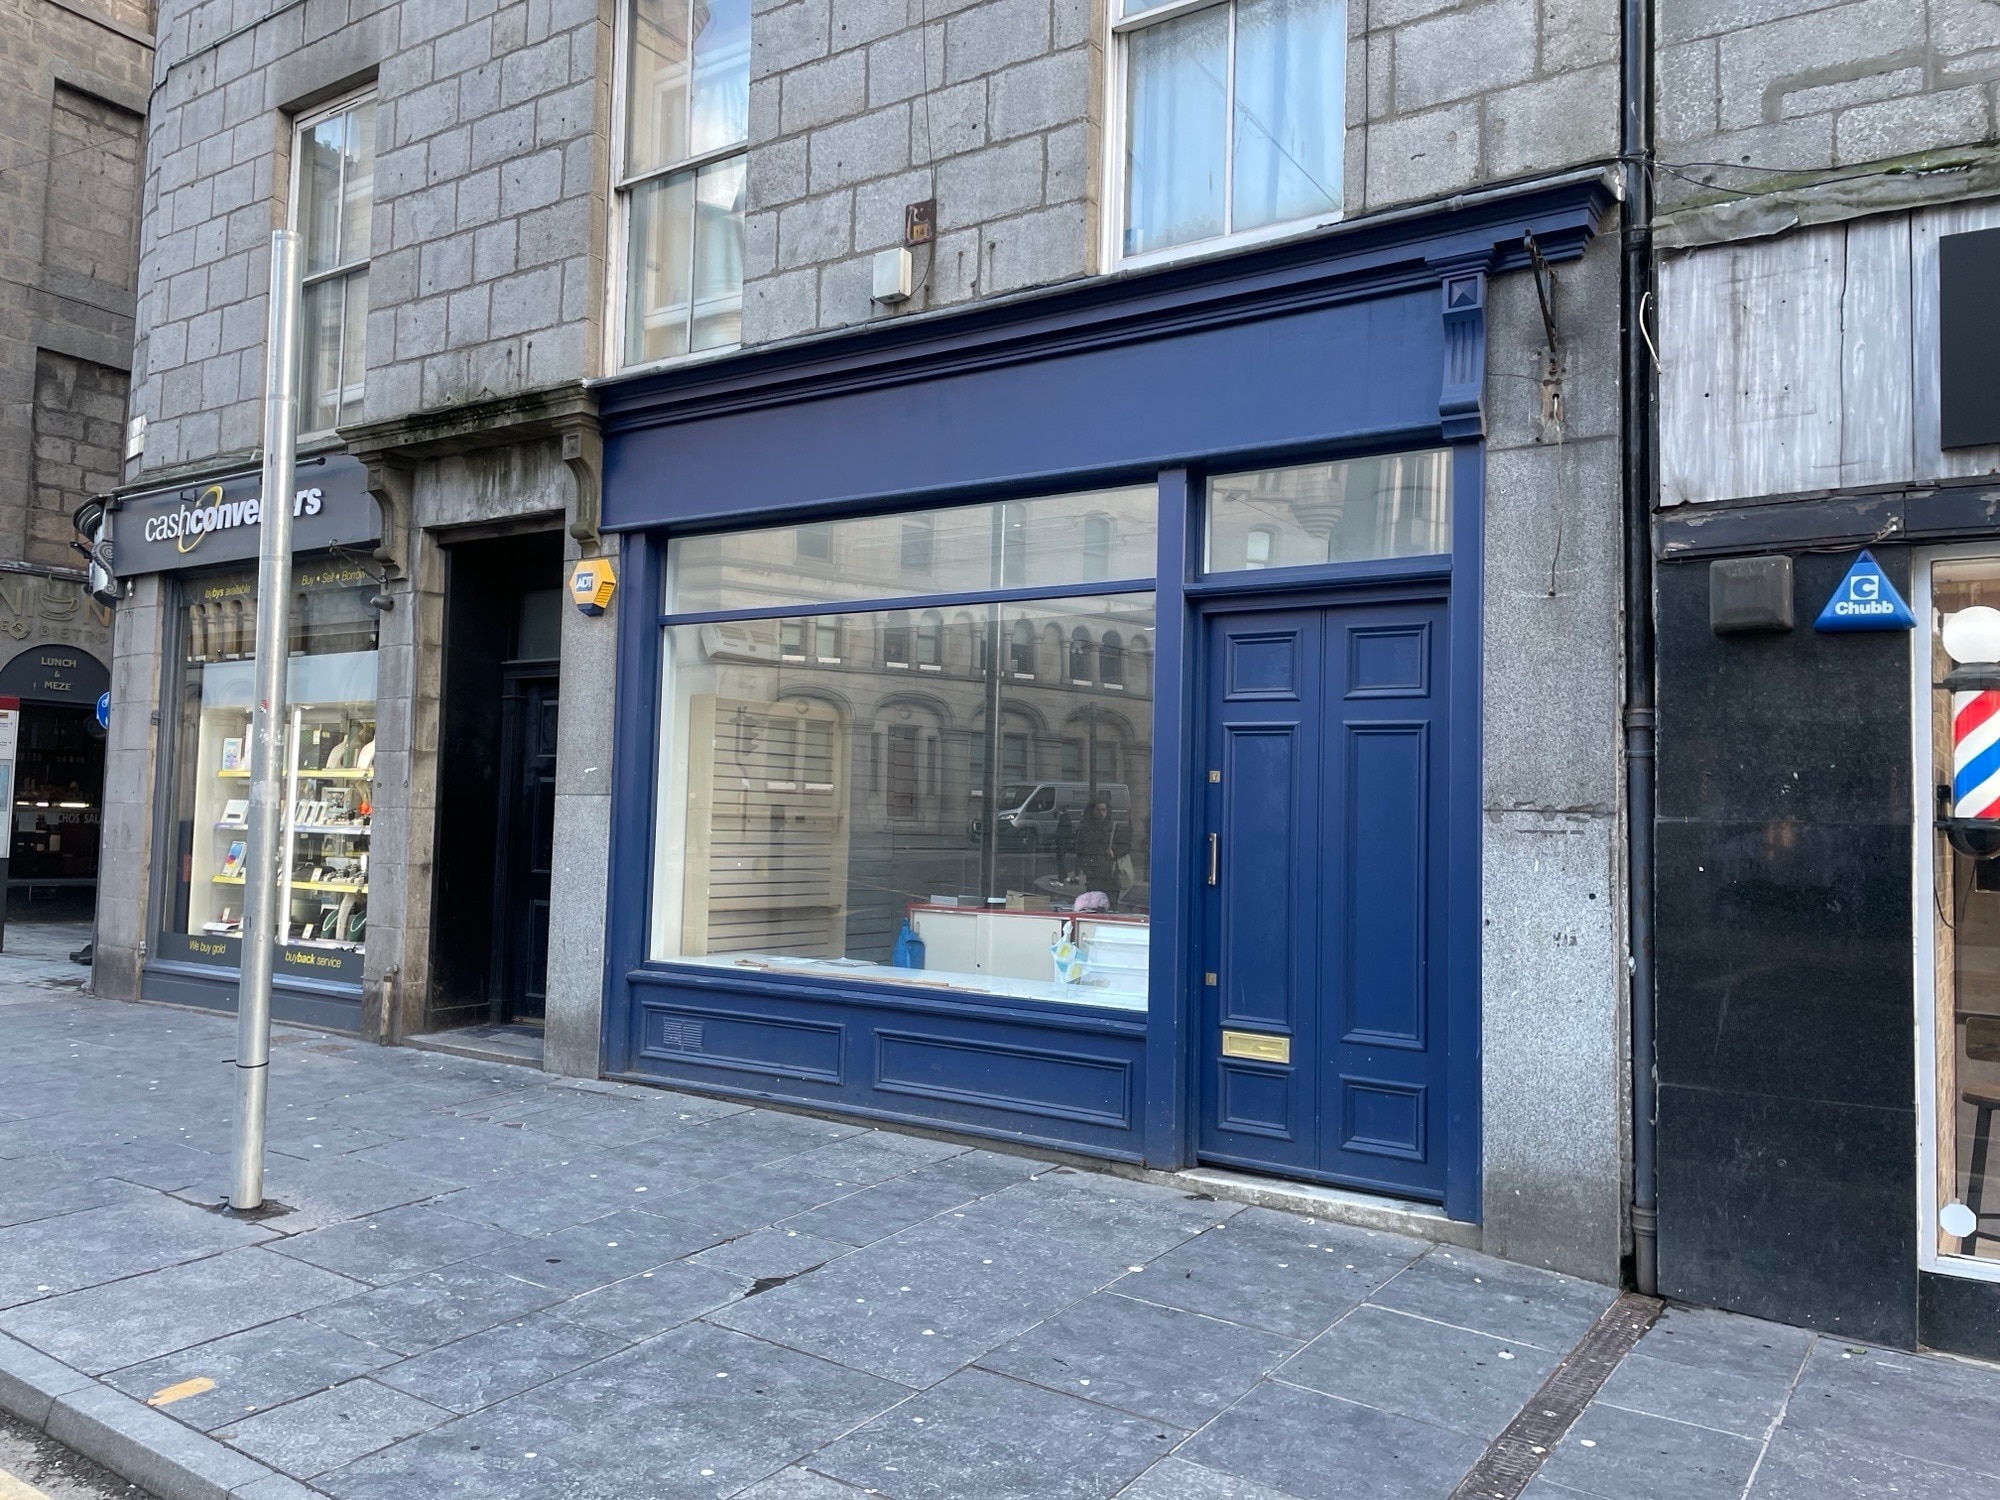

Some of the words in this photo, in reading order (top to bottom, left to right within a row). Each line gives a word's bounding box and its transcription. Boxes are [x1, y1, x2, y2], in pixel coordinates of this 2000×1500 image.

[144, 487, 322, 542] cashconvers
[301, 574, 315, 587] Buy
[321, 571, 335, 583] Sell
[341, 569, 367, 582] Borrow
[576, 576, 594, 589] ADT
[225, 584, 251, 596] available
[1835, 601, 1894, 615] Chubb
[40, 625, 109, 643] BISTRO
[41, 657, 76, 668] LUNCH
[54, 670, 60, 678] &
[44, 681, 71, 691] MEZE
[189, 940, 200, 951] We
[200, 942, 212, 954] buy
[212, 943, 226, 956] gold
[285, 951, 316, 964] buyback
[316, 956, 342, 968] service
